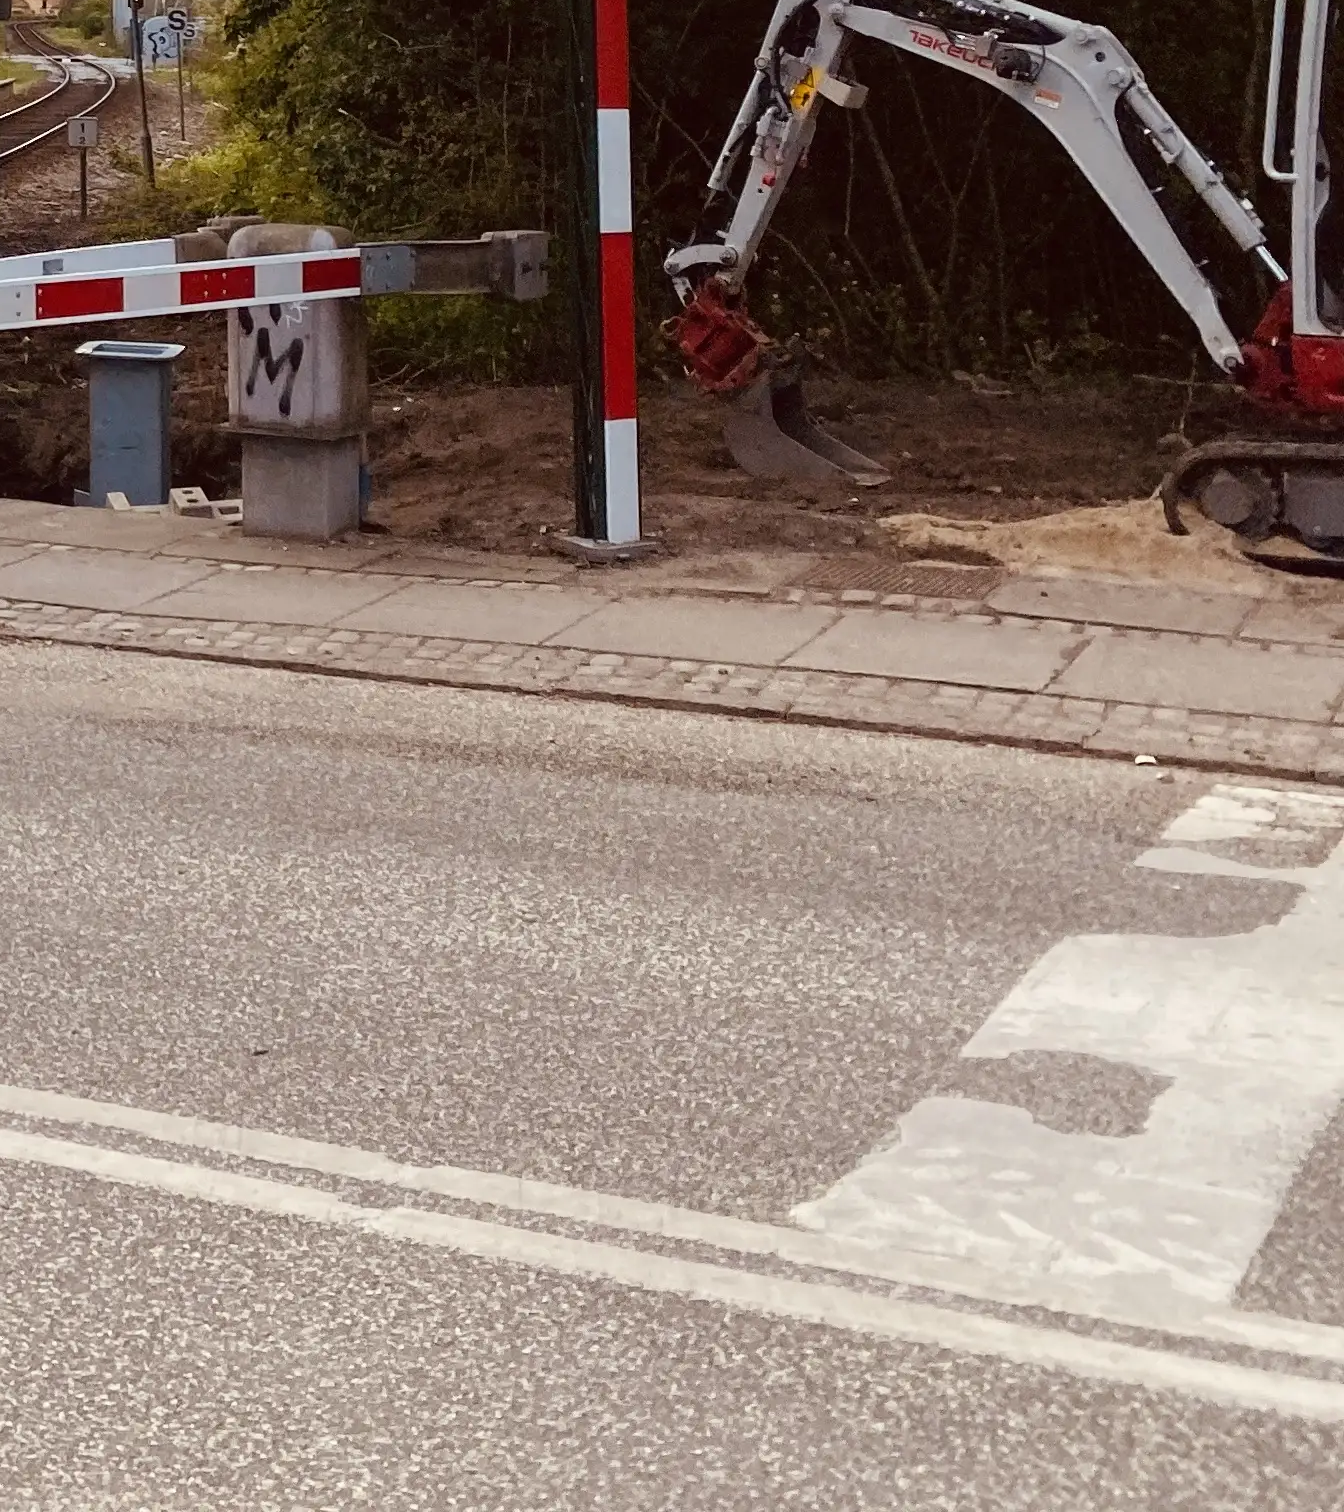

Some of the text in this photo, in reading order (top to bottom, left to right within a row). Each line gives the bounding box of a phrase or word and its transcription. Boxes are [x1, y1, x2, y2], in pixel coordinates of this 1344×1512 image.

[167, 9, 187, 31] S
[908, 29, 998, 72] TAKEUC
[245, 326, 305, 420] M
